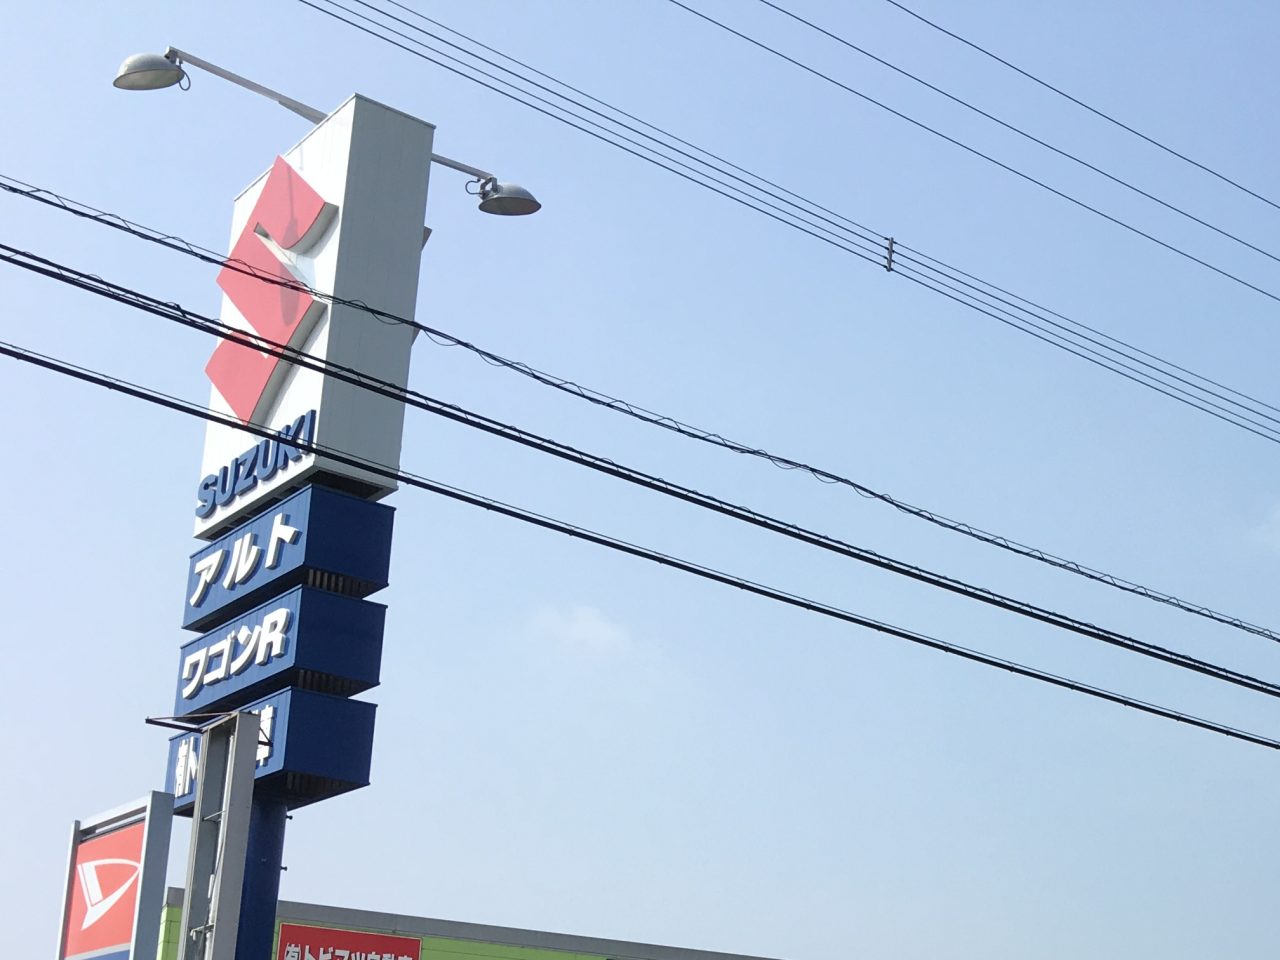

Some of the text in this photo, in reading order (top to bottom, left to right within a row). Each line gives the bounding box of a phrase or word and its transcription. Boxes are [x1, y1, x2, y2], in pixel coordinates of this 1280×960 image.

[195, 409, 316, 519] SUZUKI
[189, 513, 300, 607] アルト
[182, 607, 291, 699] ワゴンR
